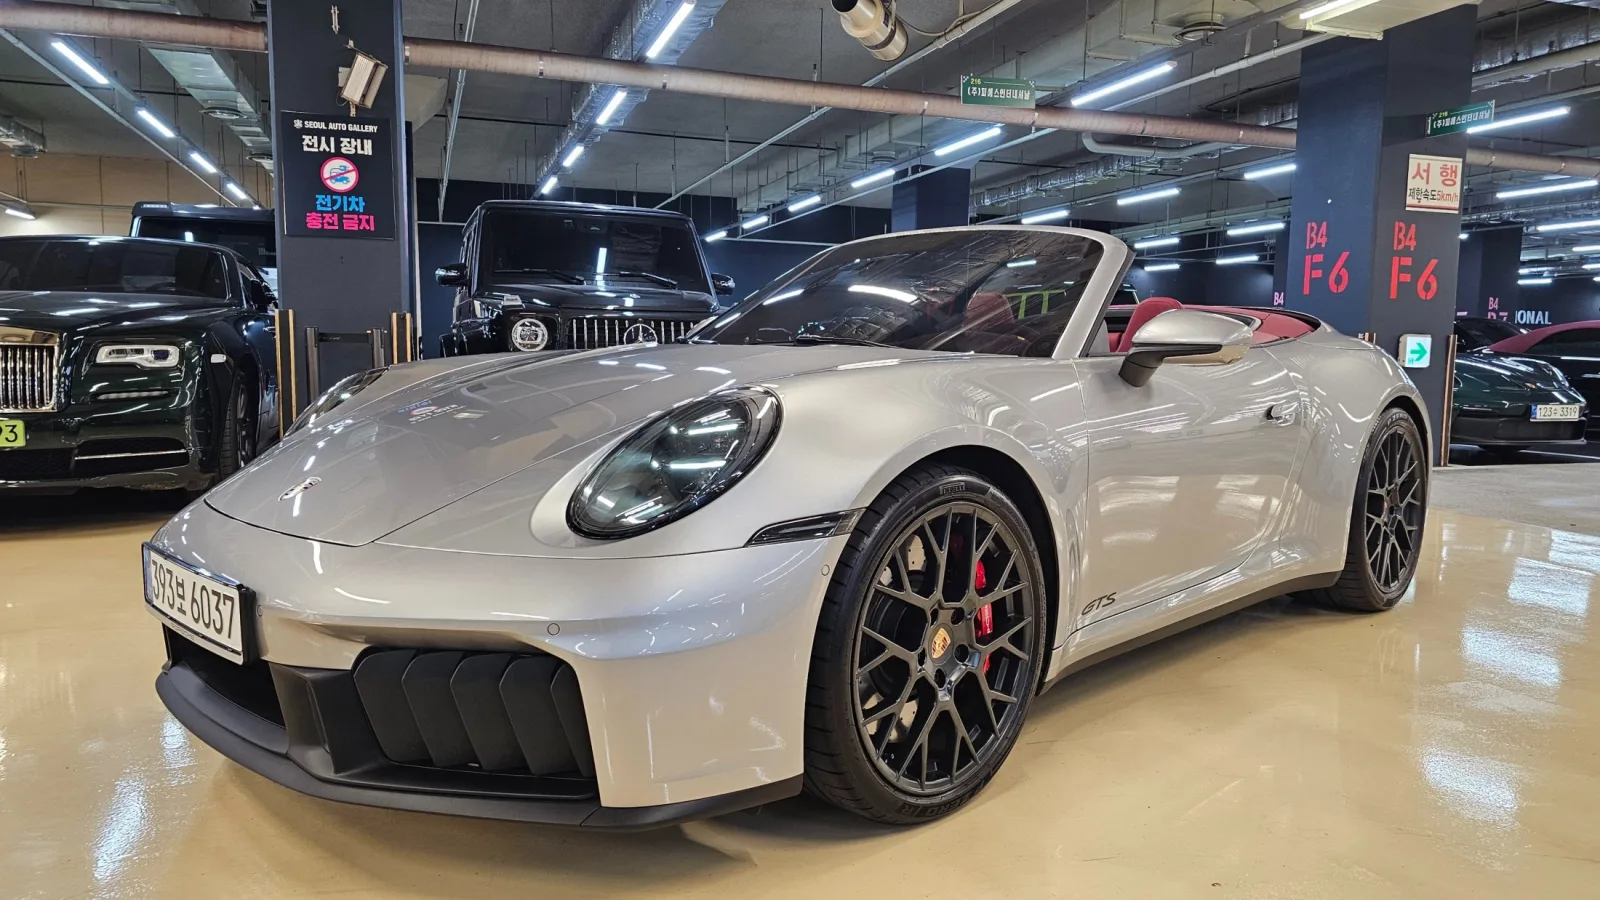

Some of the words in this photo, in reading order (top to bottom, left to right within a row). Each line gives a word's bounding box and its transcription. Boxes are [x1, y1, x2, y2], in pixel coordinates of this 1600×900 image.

[304, 120, 327, 130] SEOUL
[328, 122, 347, 131] AUTO
[348, 123, 378, 133] GALLERY
[301, 135, 335, 153] 전시
[340, 138, 373, 155] 장내
[315, 195, 366, 213] 전기차
[306, 212, 339, 230] 충전
[342, 214, 375, 231] 금지
[1306, 221, 1328, 250] B4
[1393, 221, 1417, 251] B4
[1273, 291, 1284, 306] B4
[1488, 296, 1499, 310] B4
[1559, 406, 1578, 417] 3319
[0, 424, 18, 443] 3
[190, 580, 236, 639] 6037
[1081, 591, 1118, 616] GTS
